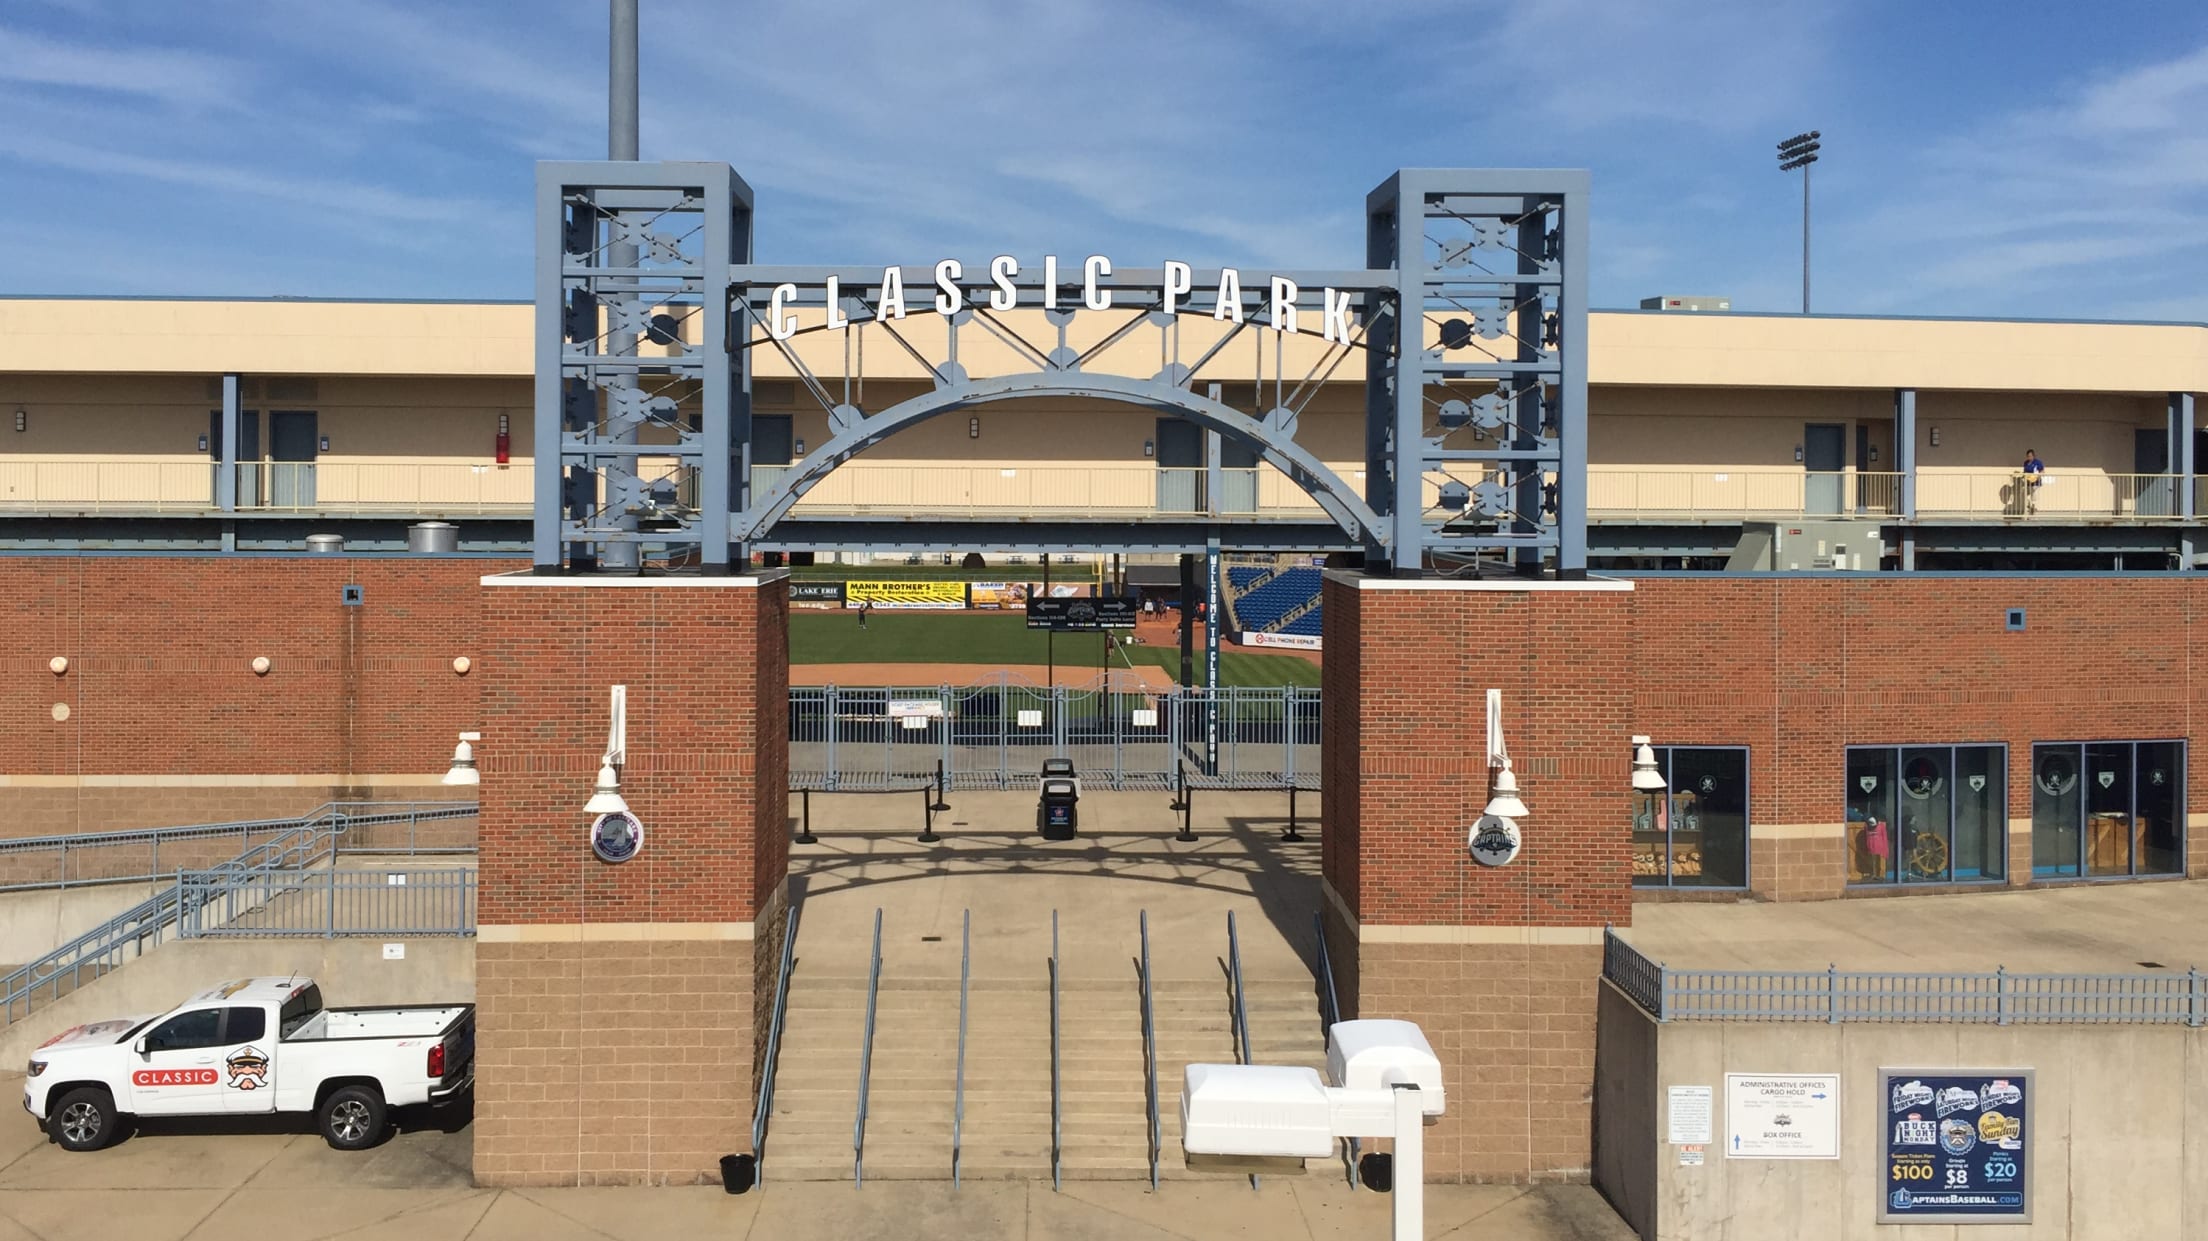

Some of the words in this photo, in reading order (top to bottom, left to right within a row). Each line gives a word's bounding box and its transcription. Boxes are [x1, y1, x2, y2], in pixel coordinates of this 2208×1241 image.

[769, 254, 1113, 341] CLASSIC
[1162, 259, 1352, 345] PARK
[1209, 555, 1217, 623] WELCOME
[1209, 627, 1216, 647] TO
[1473, 832, 1517, 846] CAPTAINS
[138, 1071, 213, 1084] CLASSIC
[1740, 1081, 1797, 1089] ADMINISTRATIVE
[1894, 1093, 1913, 1102] FRIDAY
[1895, 1096, 1933, 1111] FIREWORKS
[1937, 1098, 1961, 1108] SATURDAY
[1981, 1092, 2002, 1102] SUNDAY
[1982, 1095, 2021, 1111] FIREWORKS
[1938, 1100, 1979, 1117] FIREWORKS
[1981, 1119, 2004, 1131] Family
[1981, 1126, 2018, 1140] Sunday
[1892, 1164, 1934, 1180] $100
[1946, 1168, 1968, 1185] $8
[1984, 1162, 2017, 1178] $20
